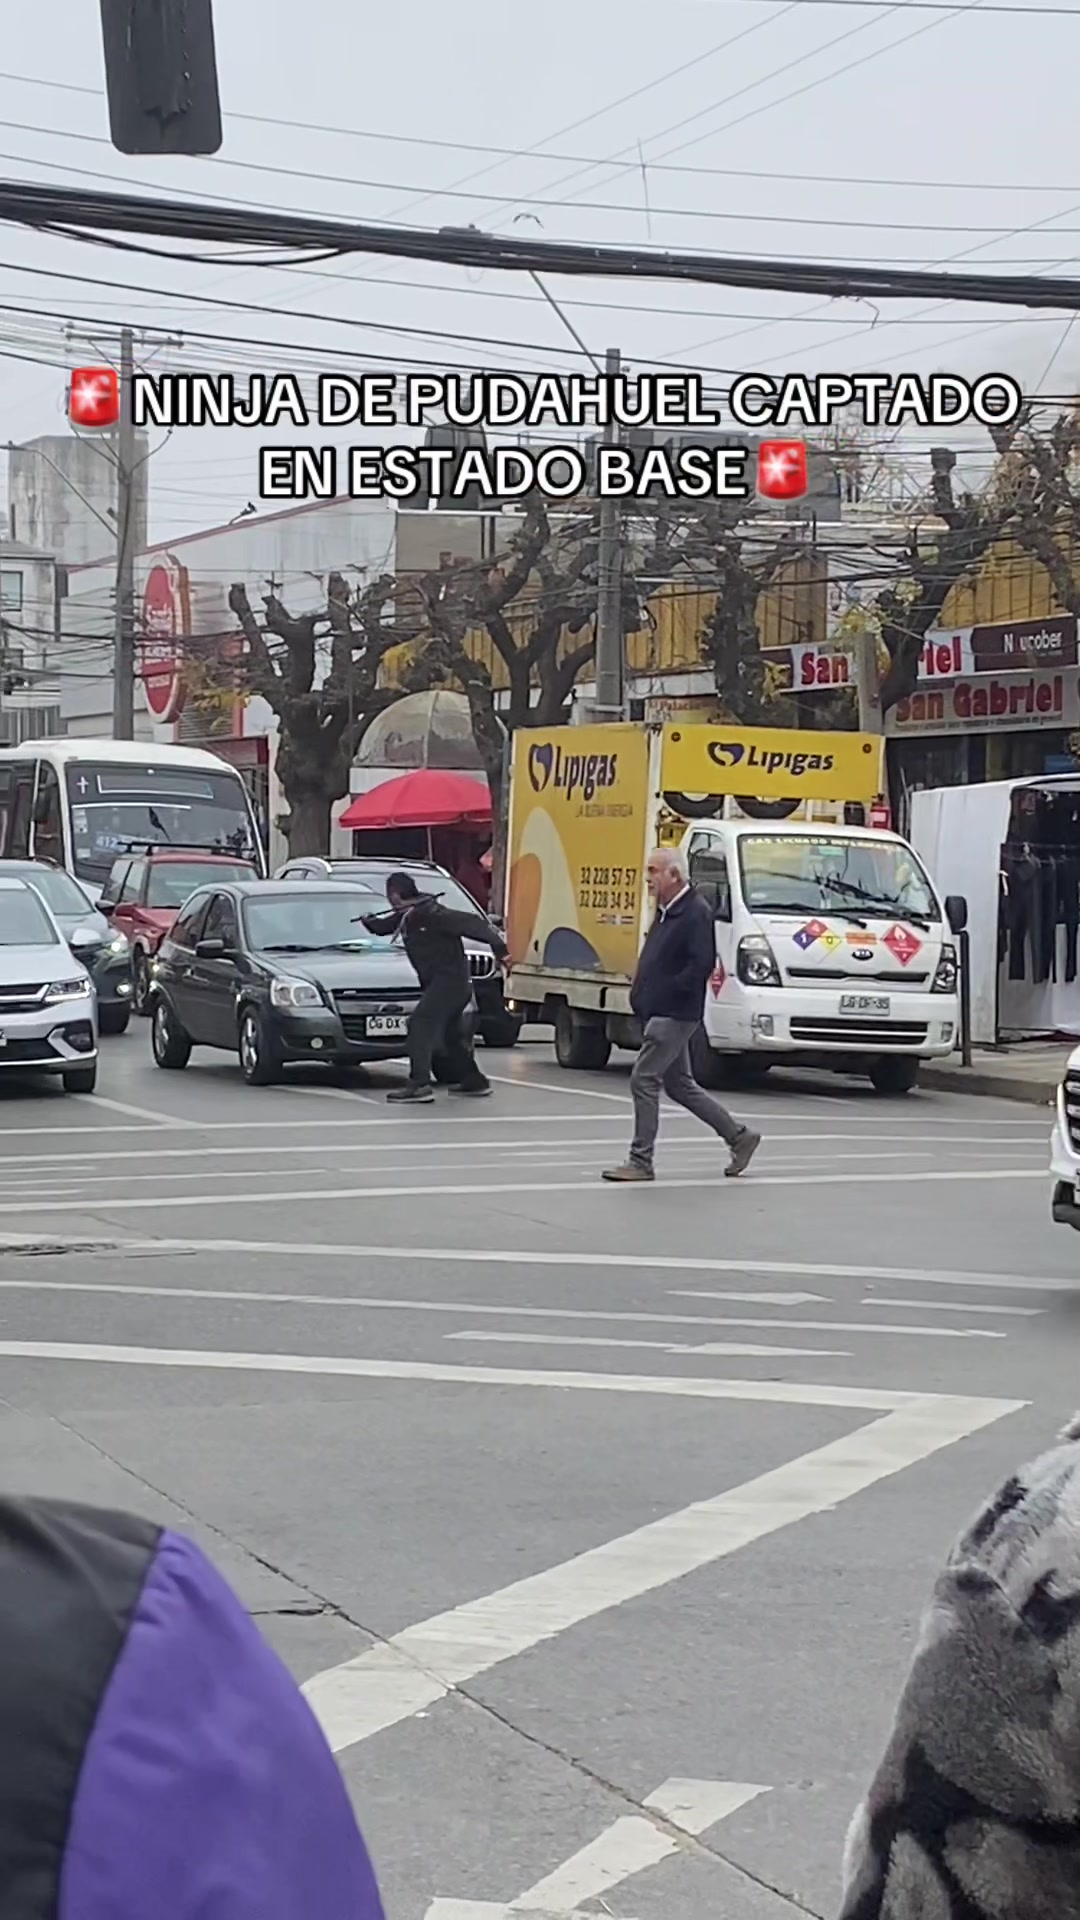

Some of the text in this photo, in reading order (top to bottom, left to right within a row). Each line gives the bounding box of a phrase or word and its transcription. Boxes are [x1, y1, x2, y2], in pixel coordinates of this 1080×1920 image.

[801, 651, 849, 686] San
[895, 675, 1064, 722] San Gabriel
[553, 745, 618, 802] Lipigas
[746, 744, 835, 776] Lipigas
[580, 866, 591, 885] 32
[611, 867, 623, 886] 57
[625, 868, 637, 887] 57
[610, 891, 622, 909] 34
[623, 891, 636, 910] 34
